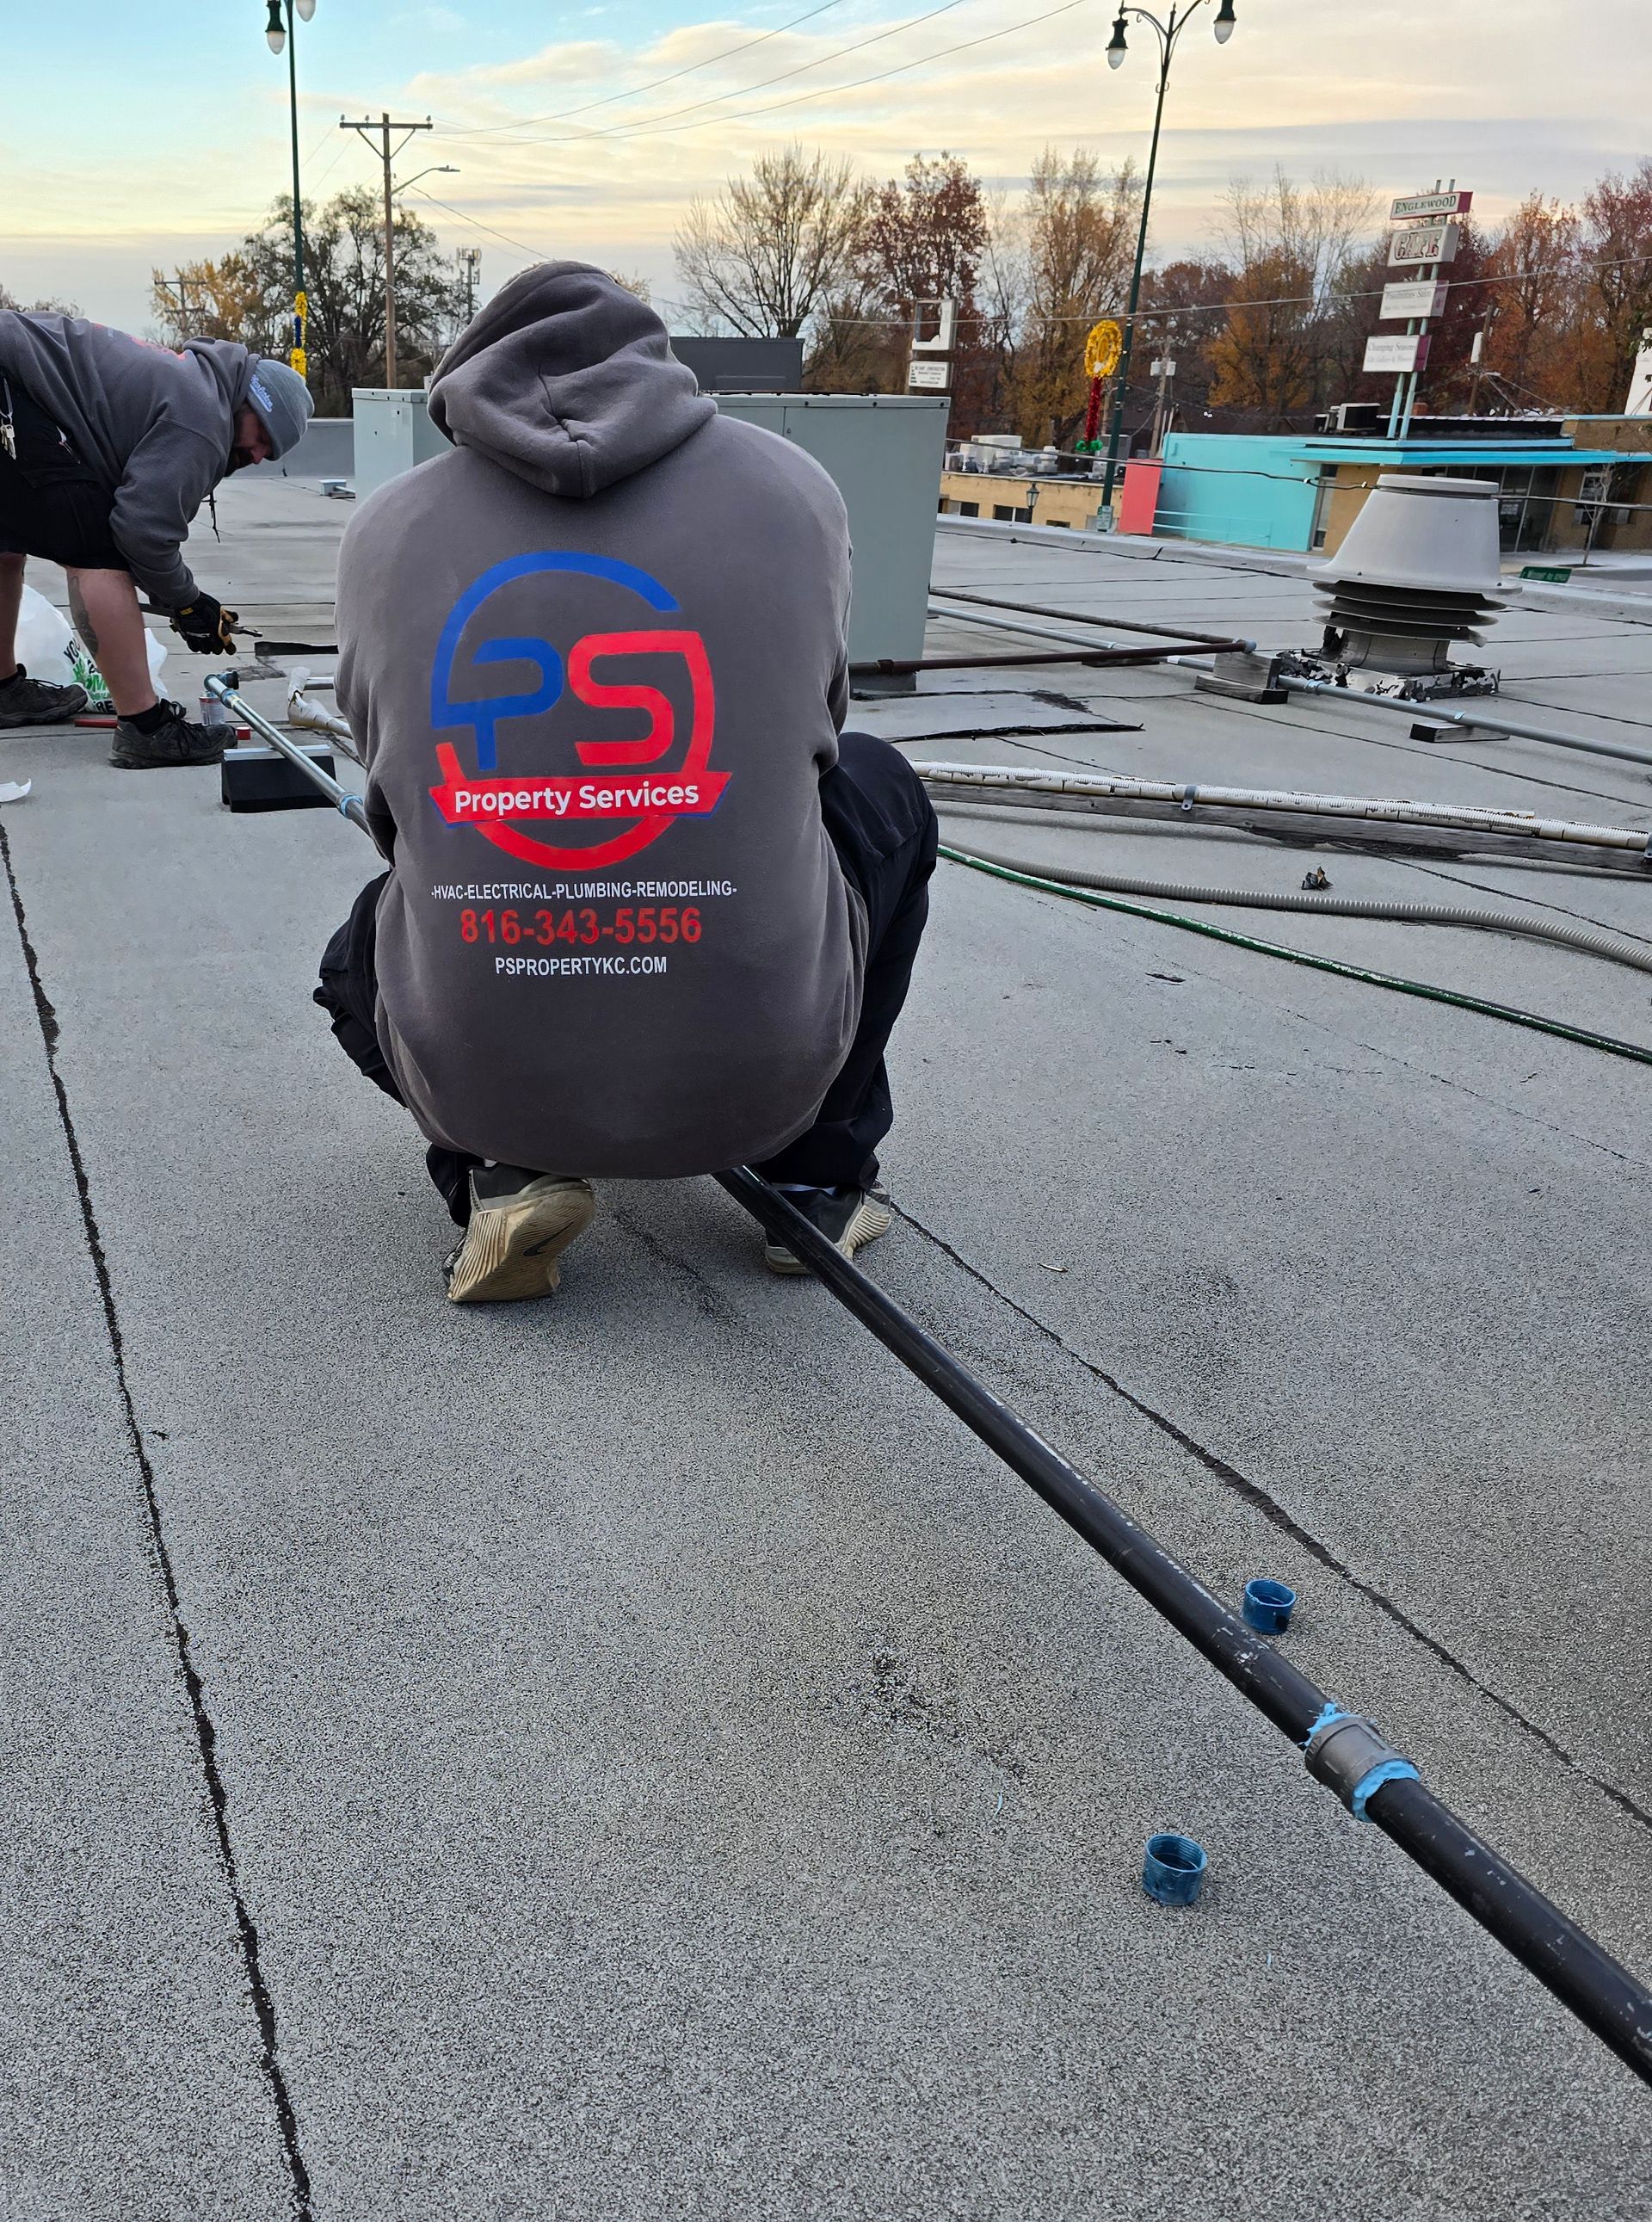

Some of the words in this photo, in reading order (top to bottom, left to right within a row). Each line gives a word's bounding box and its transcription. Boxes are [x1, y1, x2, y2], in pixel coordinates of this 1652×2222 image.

[1395, 195, 1457, 214] ENGLEWOOD
[432, 630, 714, 771] PS
[454, 788, 571, 816] Property
[578, 781, 700, 809] Services
[460, 908, 702, 946] 816-343-5556
[495, 956, 667, 976] PSPROPERTYKC.COM
